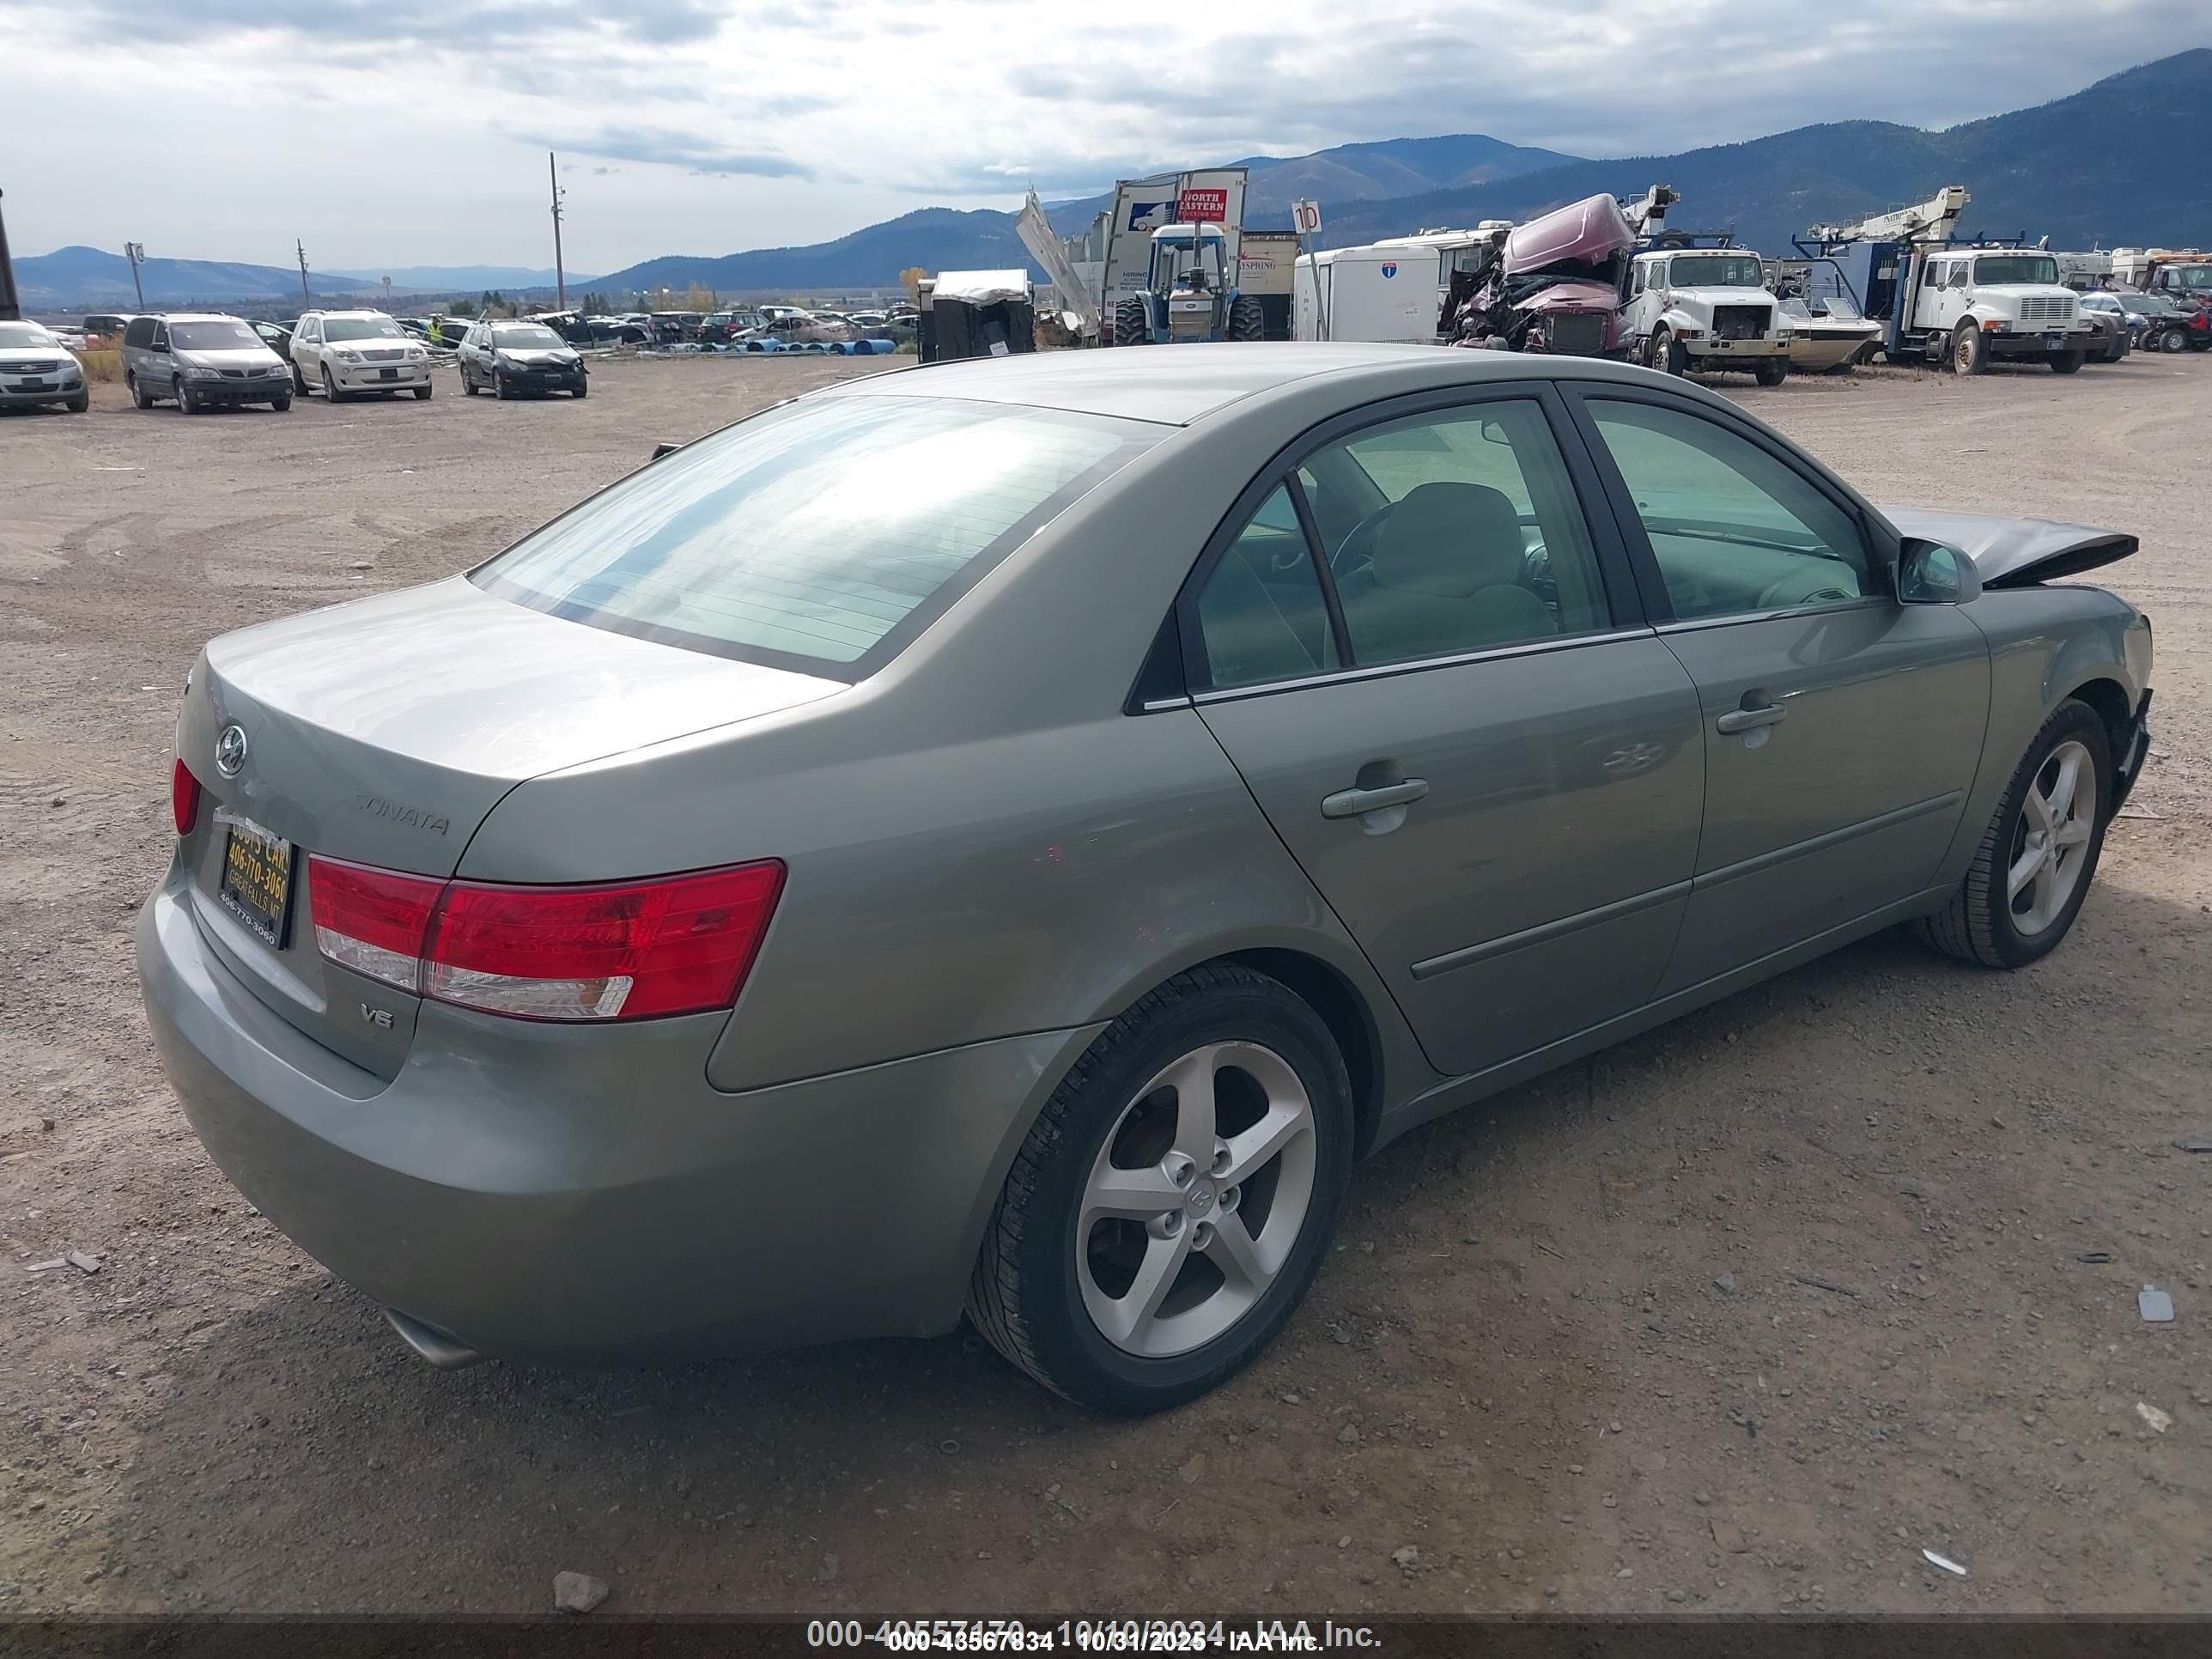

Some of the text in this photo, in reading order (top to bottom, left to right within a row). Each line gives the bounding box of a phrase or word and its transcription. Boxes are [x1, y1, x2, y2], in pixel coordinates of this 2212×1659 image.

[1179, 202, 1224, 211] EASTERN
[1184, 193, 1219, 203] NORTH
[1295, 206, 1317, 229] 10
[228, 842, 287, 903] 406-770-3060
[228, 869, 248, 895] GREAT
[220, 893, 276, 945] 406-770-3060
[360, 1002, 394, 1030] V6
